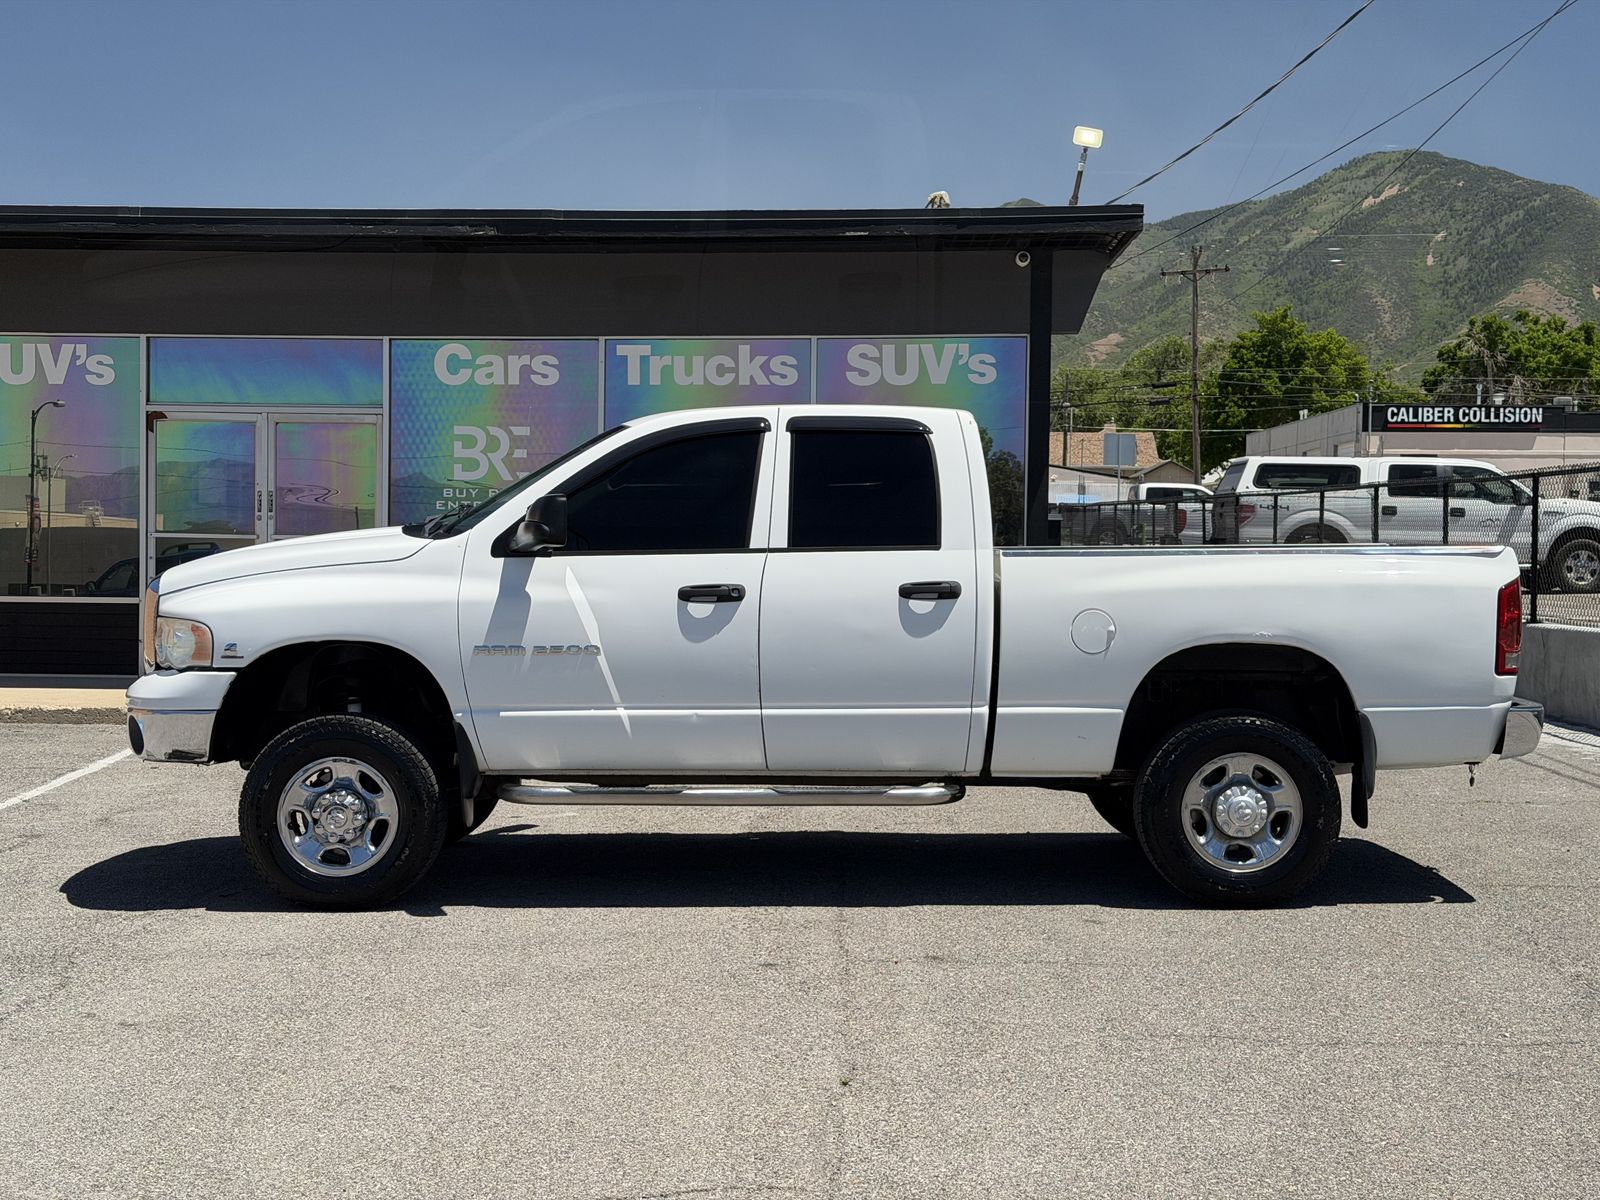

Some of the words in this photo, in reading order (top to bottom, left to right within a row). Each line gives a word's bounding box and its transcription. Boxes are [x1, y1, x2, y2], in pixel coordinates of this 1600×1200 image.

[433, 343, 560, 385] Cars
[616, 344, 799, 385] Trucks
[845, 344, 997, 385] SUV's
[1387, 407, 1454, 423] CALIBER
[1458, 407, 1543, 423] COLLISION
[443, 488, 479, 497] BUY
[474, 644, 526, 656] RAM
[532, 644, 601, 656] 2500
